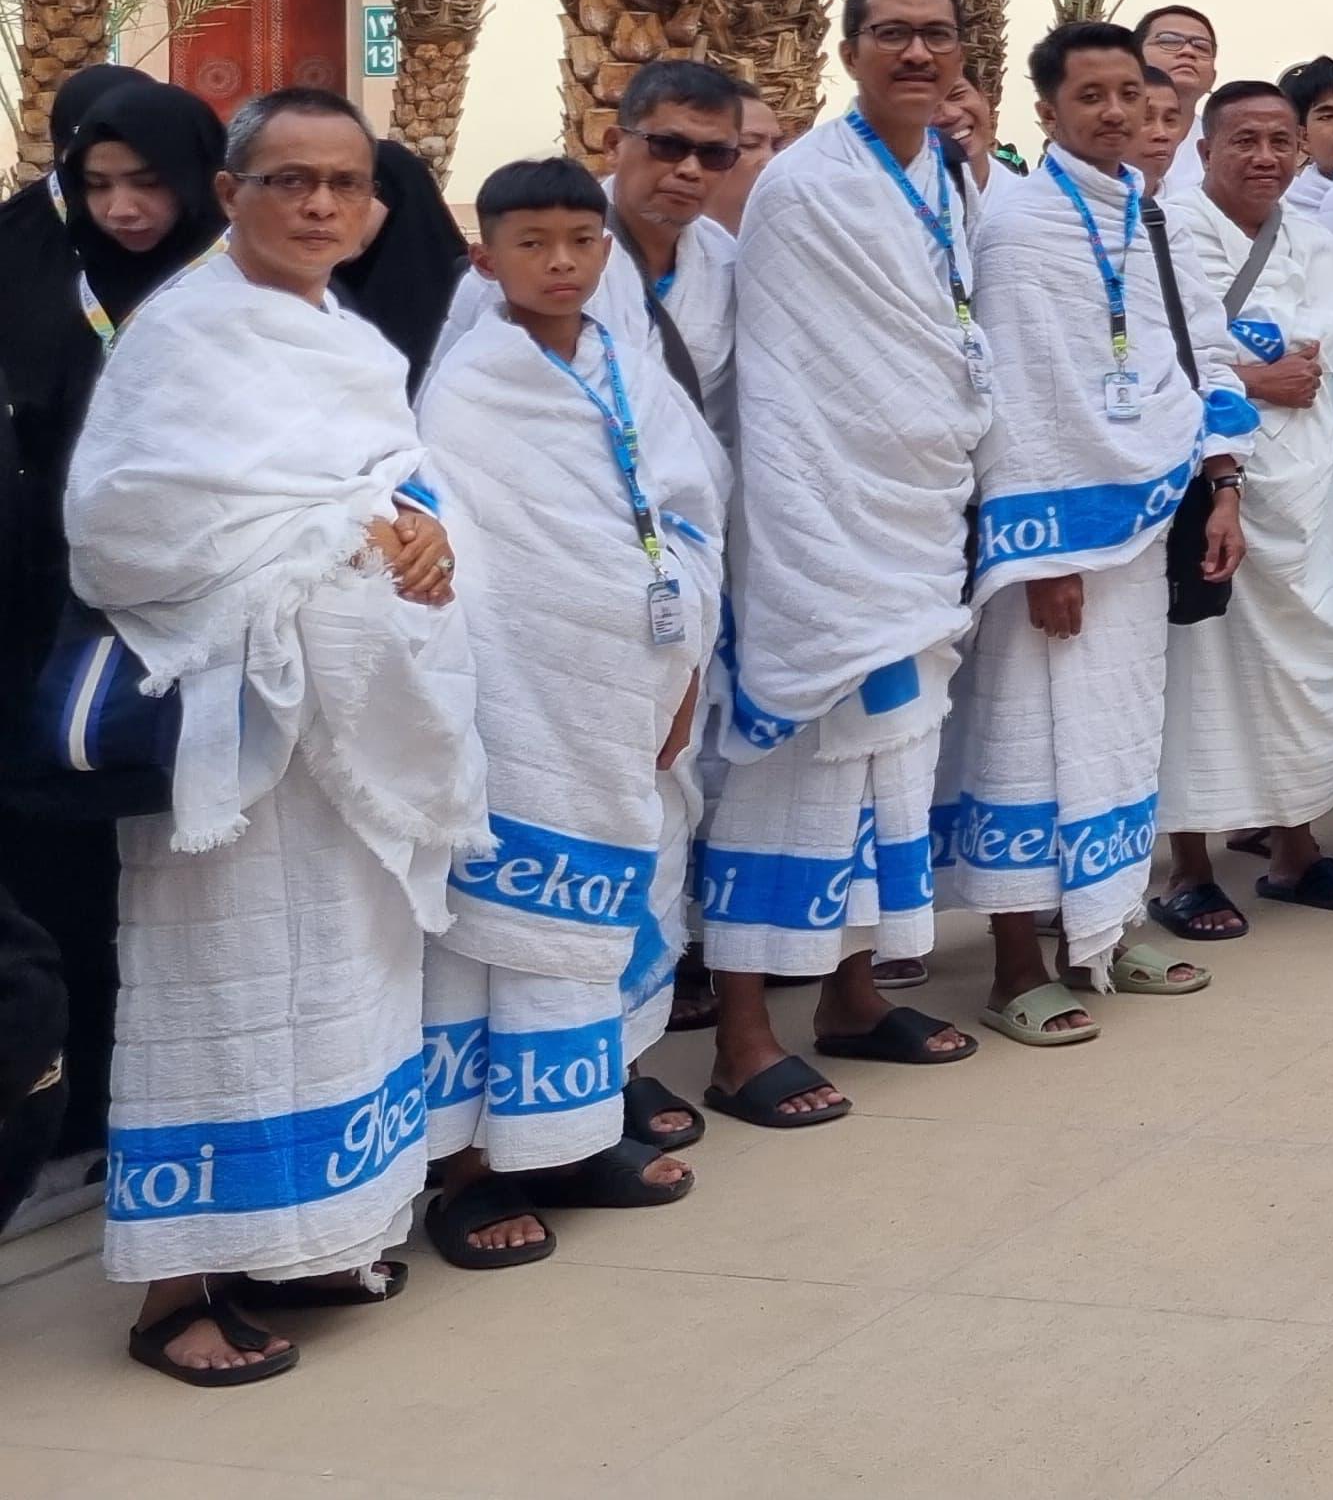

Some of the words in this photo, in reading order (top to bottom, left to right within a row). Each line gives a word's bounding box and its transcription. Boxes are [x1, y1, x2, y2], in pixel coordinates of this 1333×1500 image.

[367, 44, 394, 68] 13
[976, 506, 1062, 568] koi
[106, 1143, 215, 1212] koi
